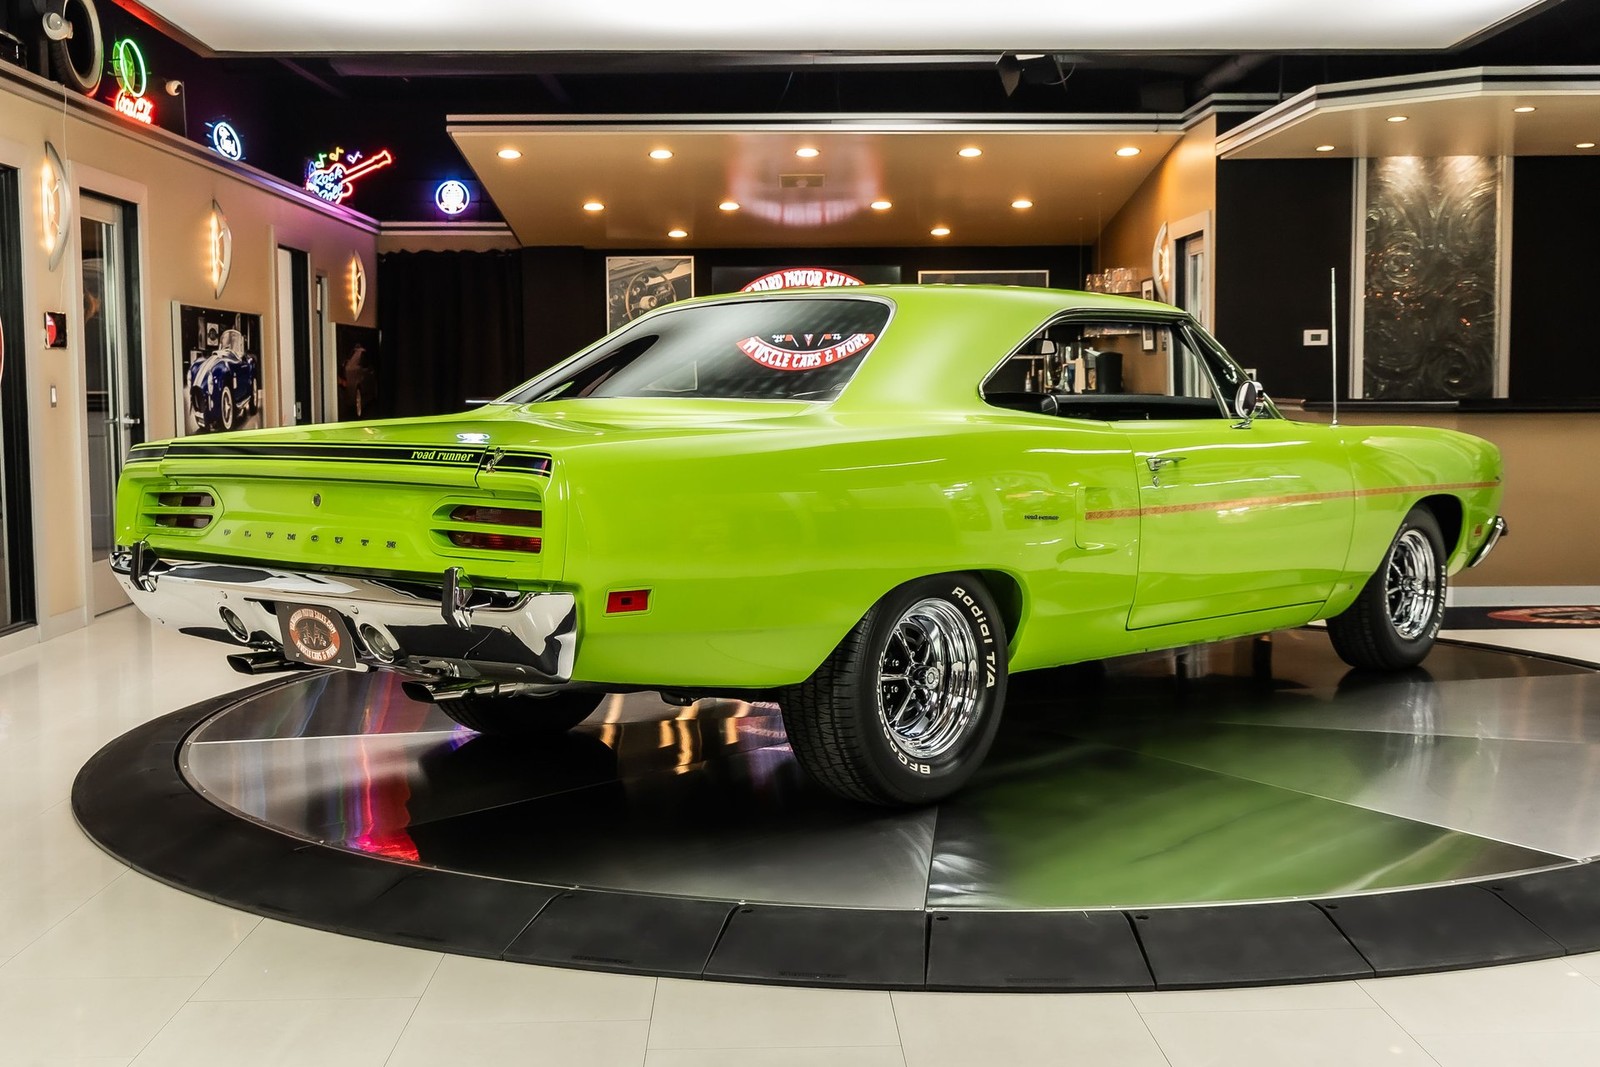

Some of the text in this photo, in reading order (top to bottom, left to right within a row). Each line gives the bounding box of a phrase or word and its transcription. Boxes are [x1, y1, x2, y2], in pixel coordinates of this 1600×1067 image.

[784, 270, 823, 287] MOTOR
[743, 333, 869, 368] MUSCLE CARS & MORE
[411, 450, 475, 462] road runner
[223, 529, 396, 549] PLYMOUTH
[951, 586, 996, 688] Radial T/A
